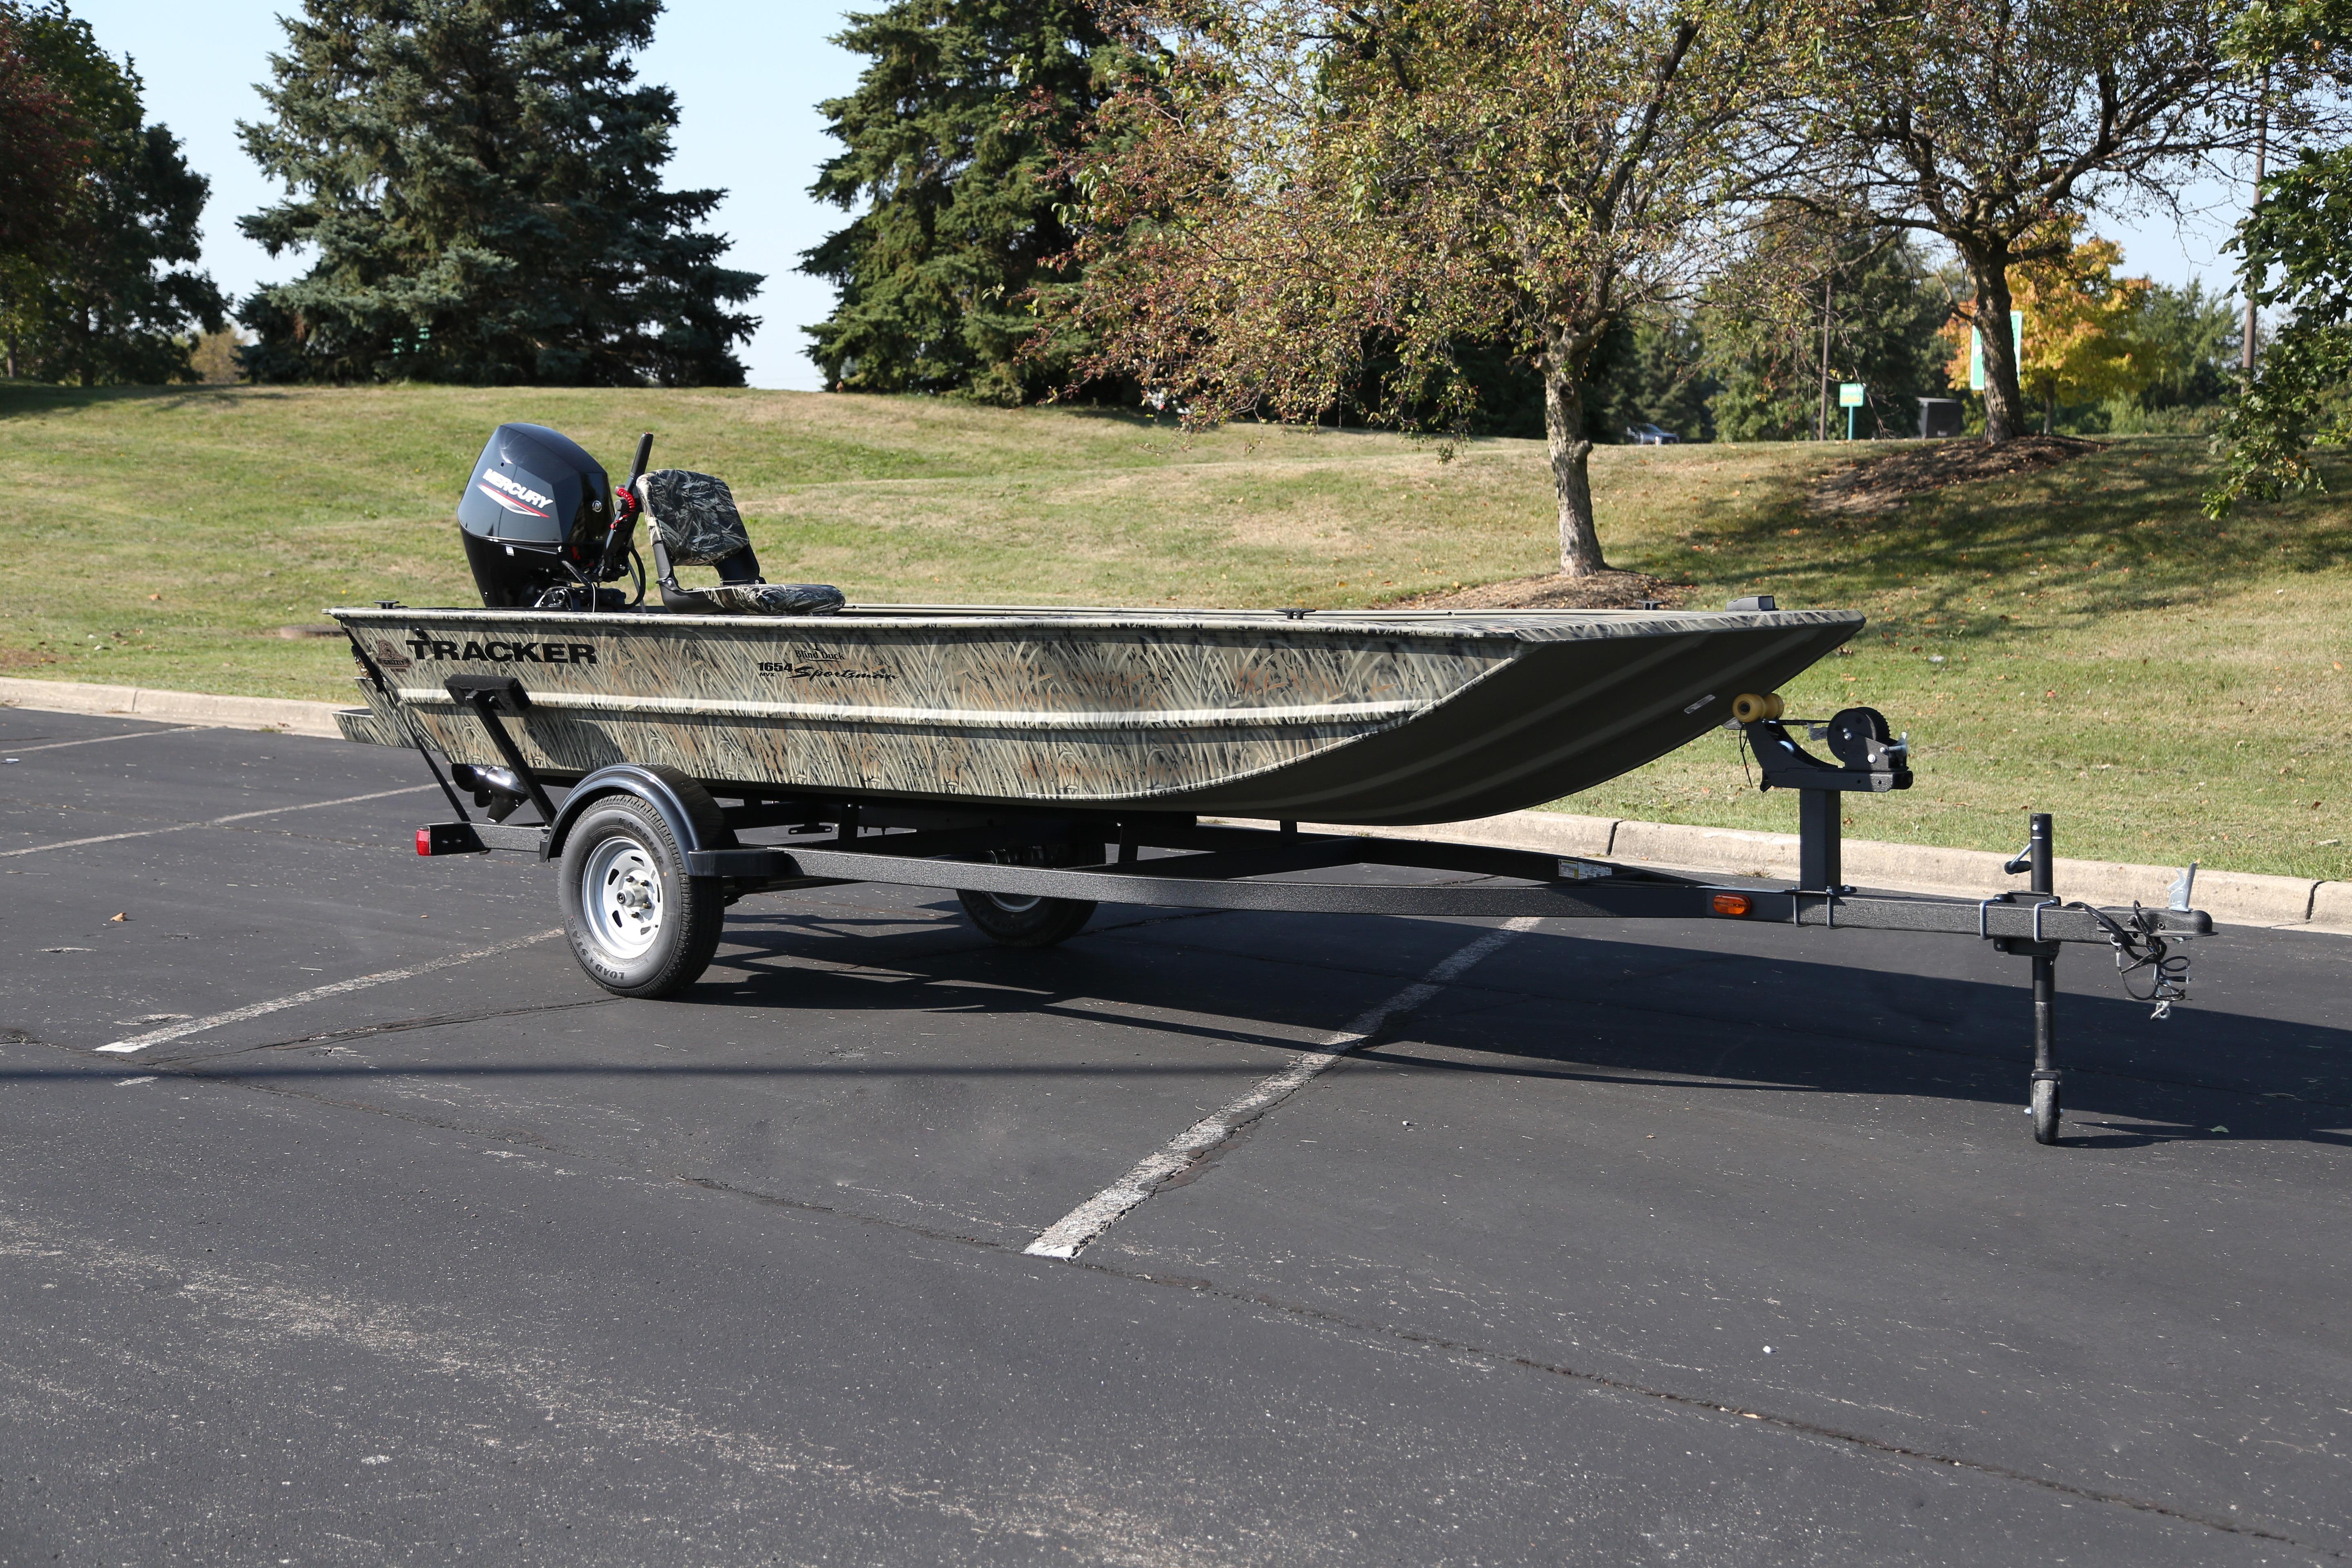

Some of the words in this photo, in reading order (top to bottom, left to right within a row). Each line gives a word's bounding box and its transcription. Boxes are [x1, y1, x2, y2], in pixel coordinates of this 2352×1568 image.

[482, 468, 553, 508] MERCURY
[405, 640, 597, 664] TRACKER
[796, 650, 819, 659] Blind
[822, 651, 845, 660] Duck
[757, 662, 793, 672] 1654
[786, 666, 900, 681] Sportsman
[618, 818, 664, 865] KARRIER
[568, 918, 588, 956] STAR
[595, 964, 625, 980] LOAD
